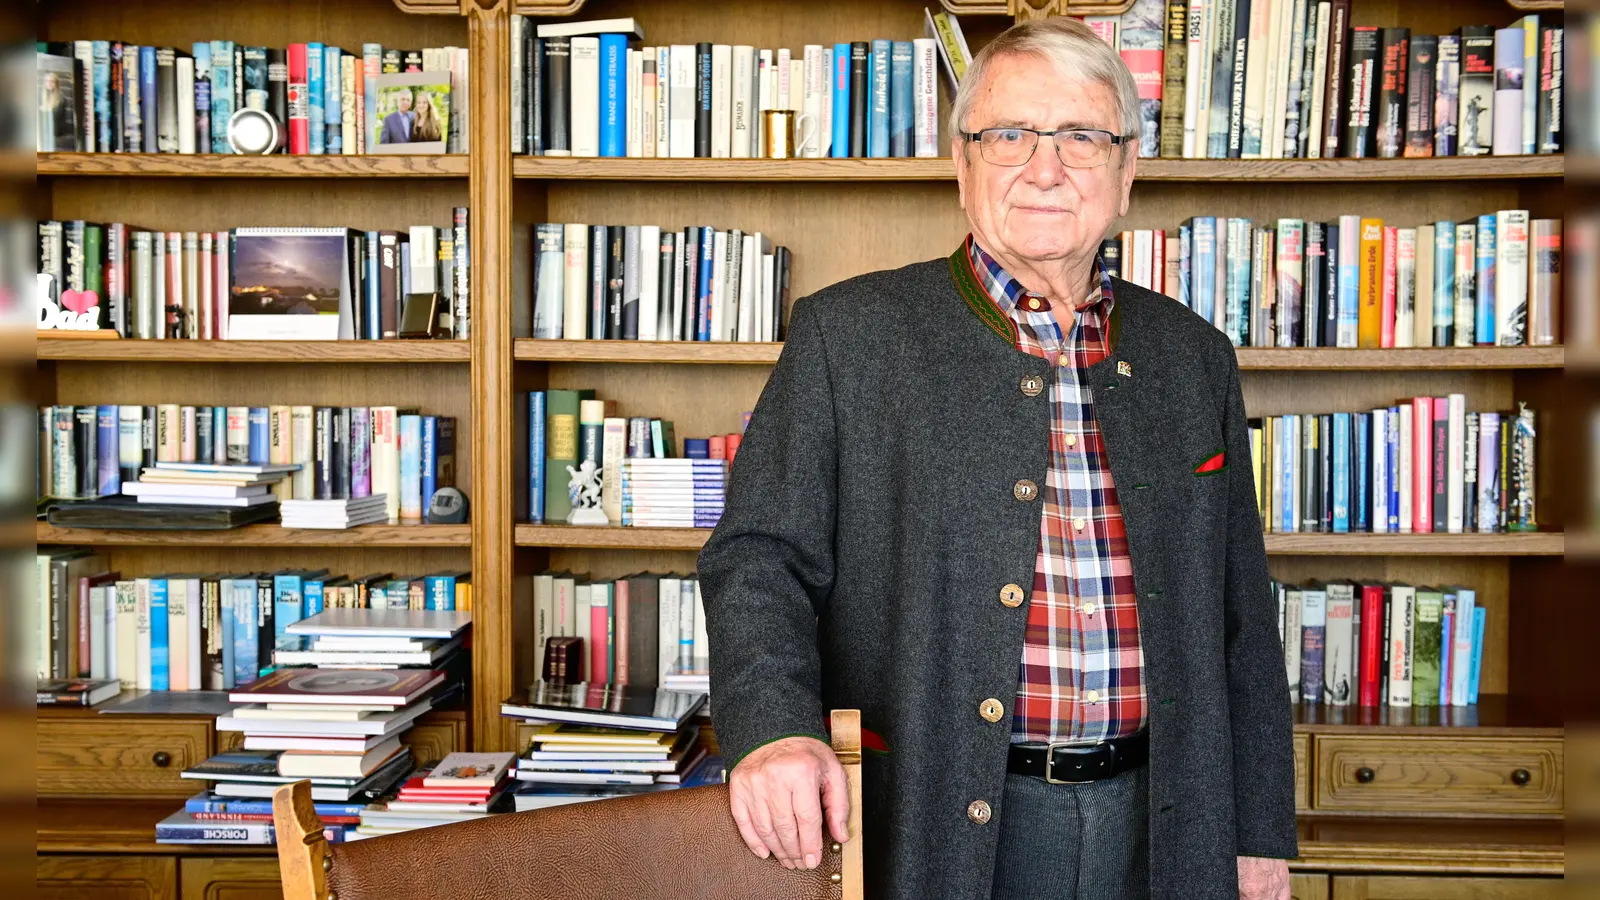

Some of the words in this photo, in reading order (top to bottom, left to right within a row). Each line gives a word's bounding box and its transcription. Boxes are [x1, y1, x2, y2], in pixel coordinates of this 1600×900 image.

[608, 45, 617, 77] STRAUSS
[702, 53, 711, 78] SÖDER
[924, 48, 933, 94] Geschichte
[608, 79, 617, 99] JOSEF
[702, 80, 711, 111] MARKUS
[608, 101, 617, 125] FRANZ
[455, 226, 466, 247] Tod
[703, 226, 713, 260] Campus
[272, 411, 280, 447] KONSALIK
[203, 829, 247, 840] PORSCHE
